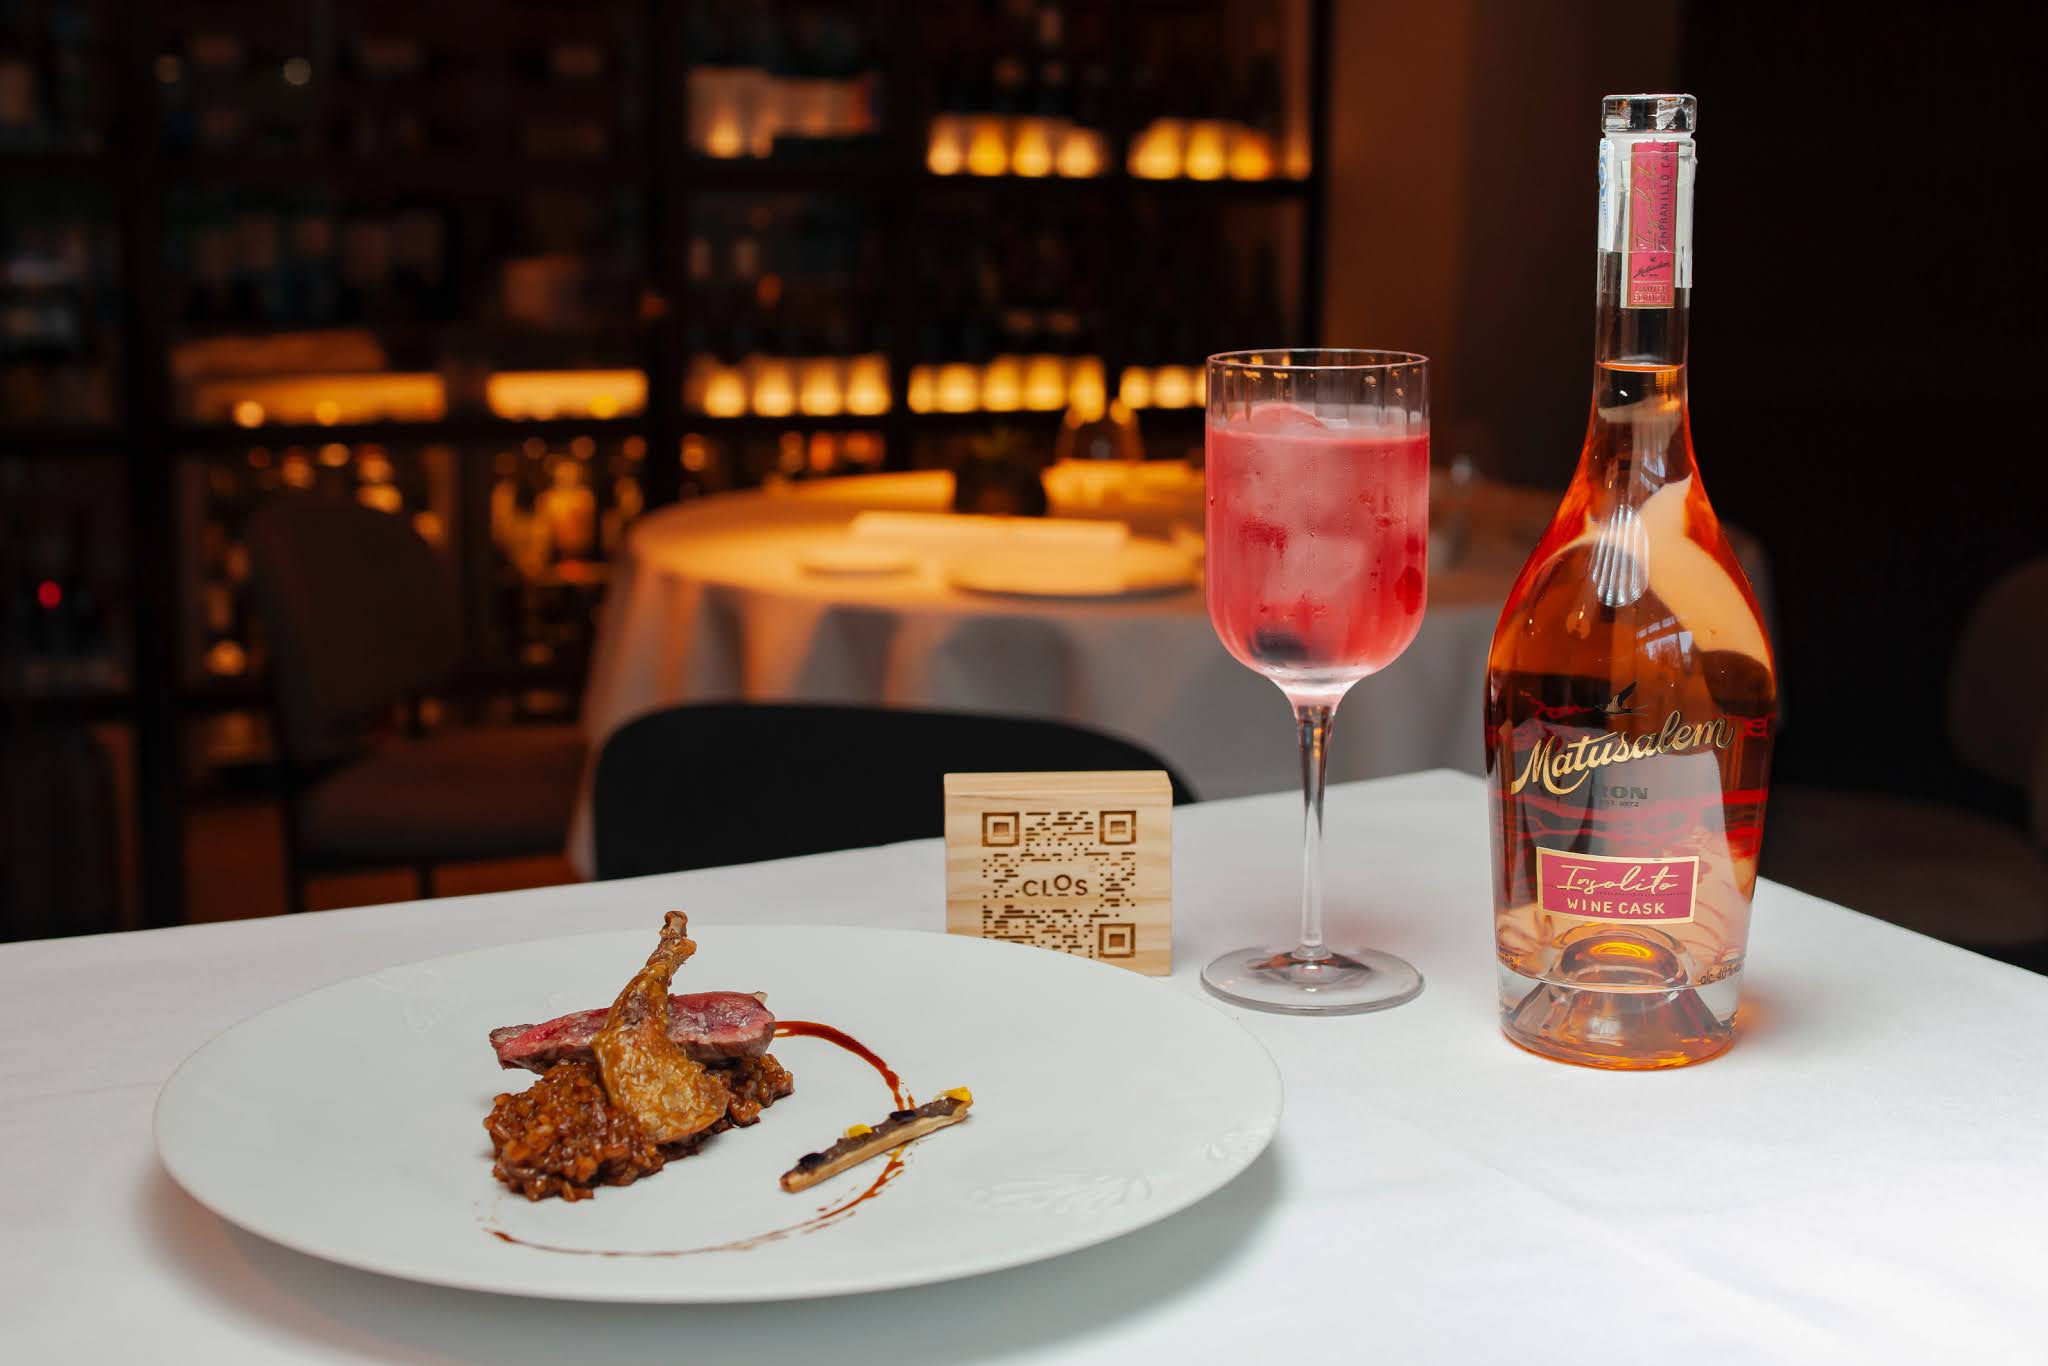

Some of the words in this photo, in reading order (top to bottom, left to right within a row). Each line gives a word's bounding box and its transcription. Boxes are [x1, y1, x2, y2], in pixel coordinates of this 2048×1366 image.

[1510, 710, 1735, 795] Matusalem
[1022, 874, 1088, 897] CLOS
[1557, 865, 1680, 895] Insolito
[1567, 898, 1614, 913] WINE
[1618, 902, 1666, 915] CASK
